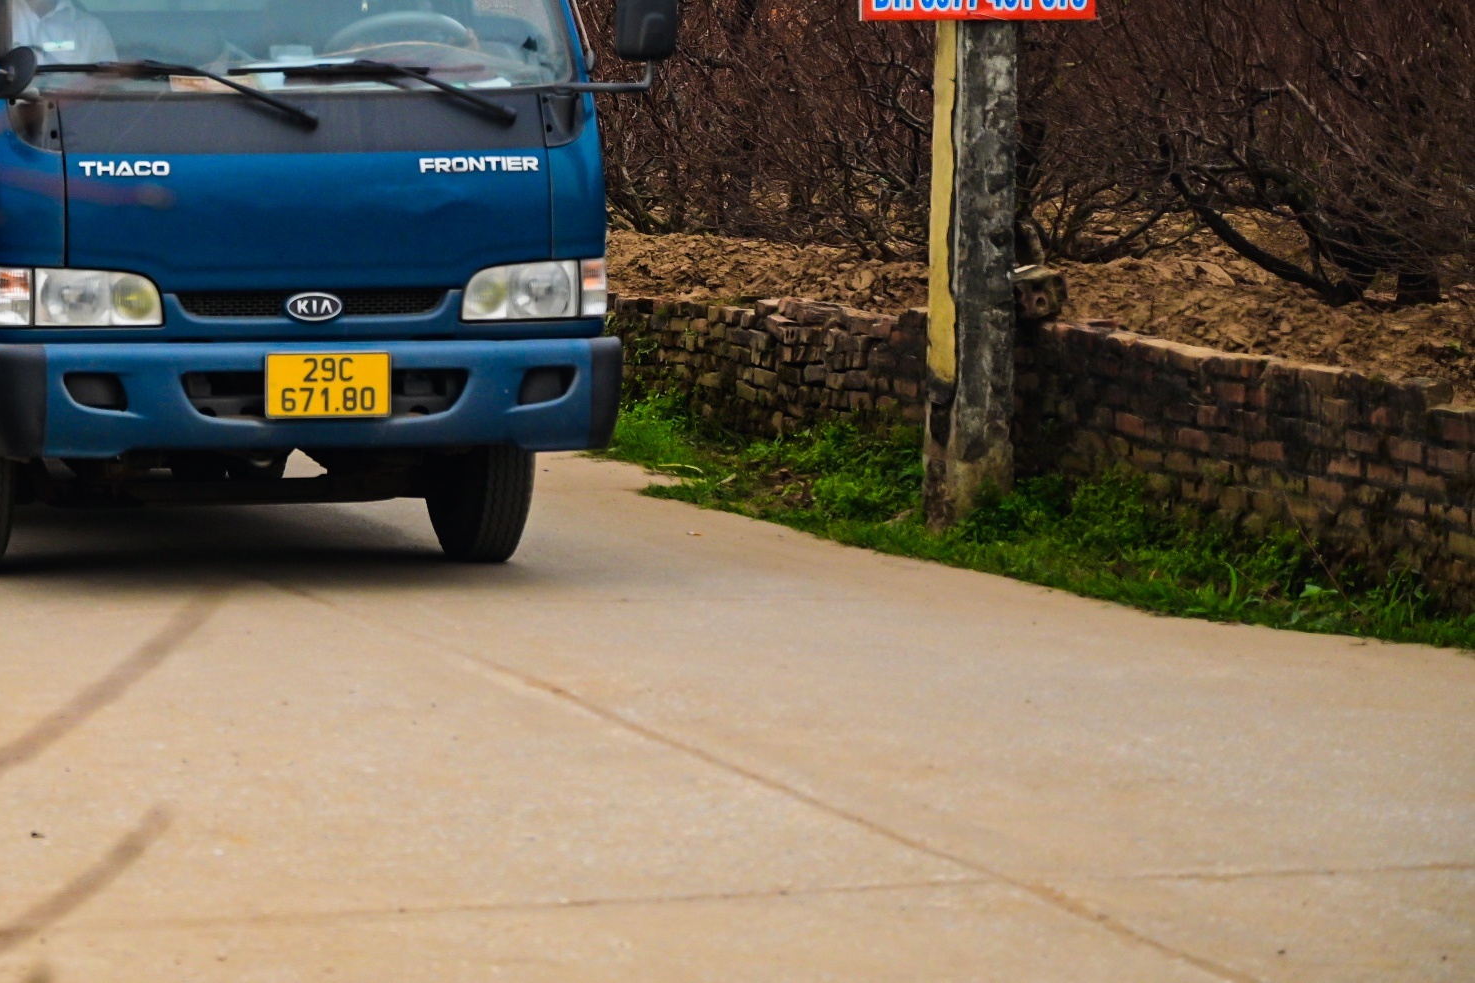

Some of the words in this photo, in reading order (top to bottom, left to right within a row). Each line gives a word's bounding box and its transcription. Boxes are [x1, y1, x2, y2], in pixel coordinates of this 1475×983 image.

[79, 160, 171, 177] THACO
[419, 156, 540, 173] FRONTIER
[296, 298, 334, 315] KIA
[303, 357, 354, 383] 29C
[281, 386, 376, 412] 671.80
